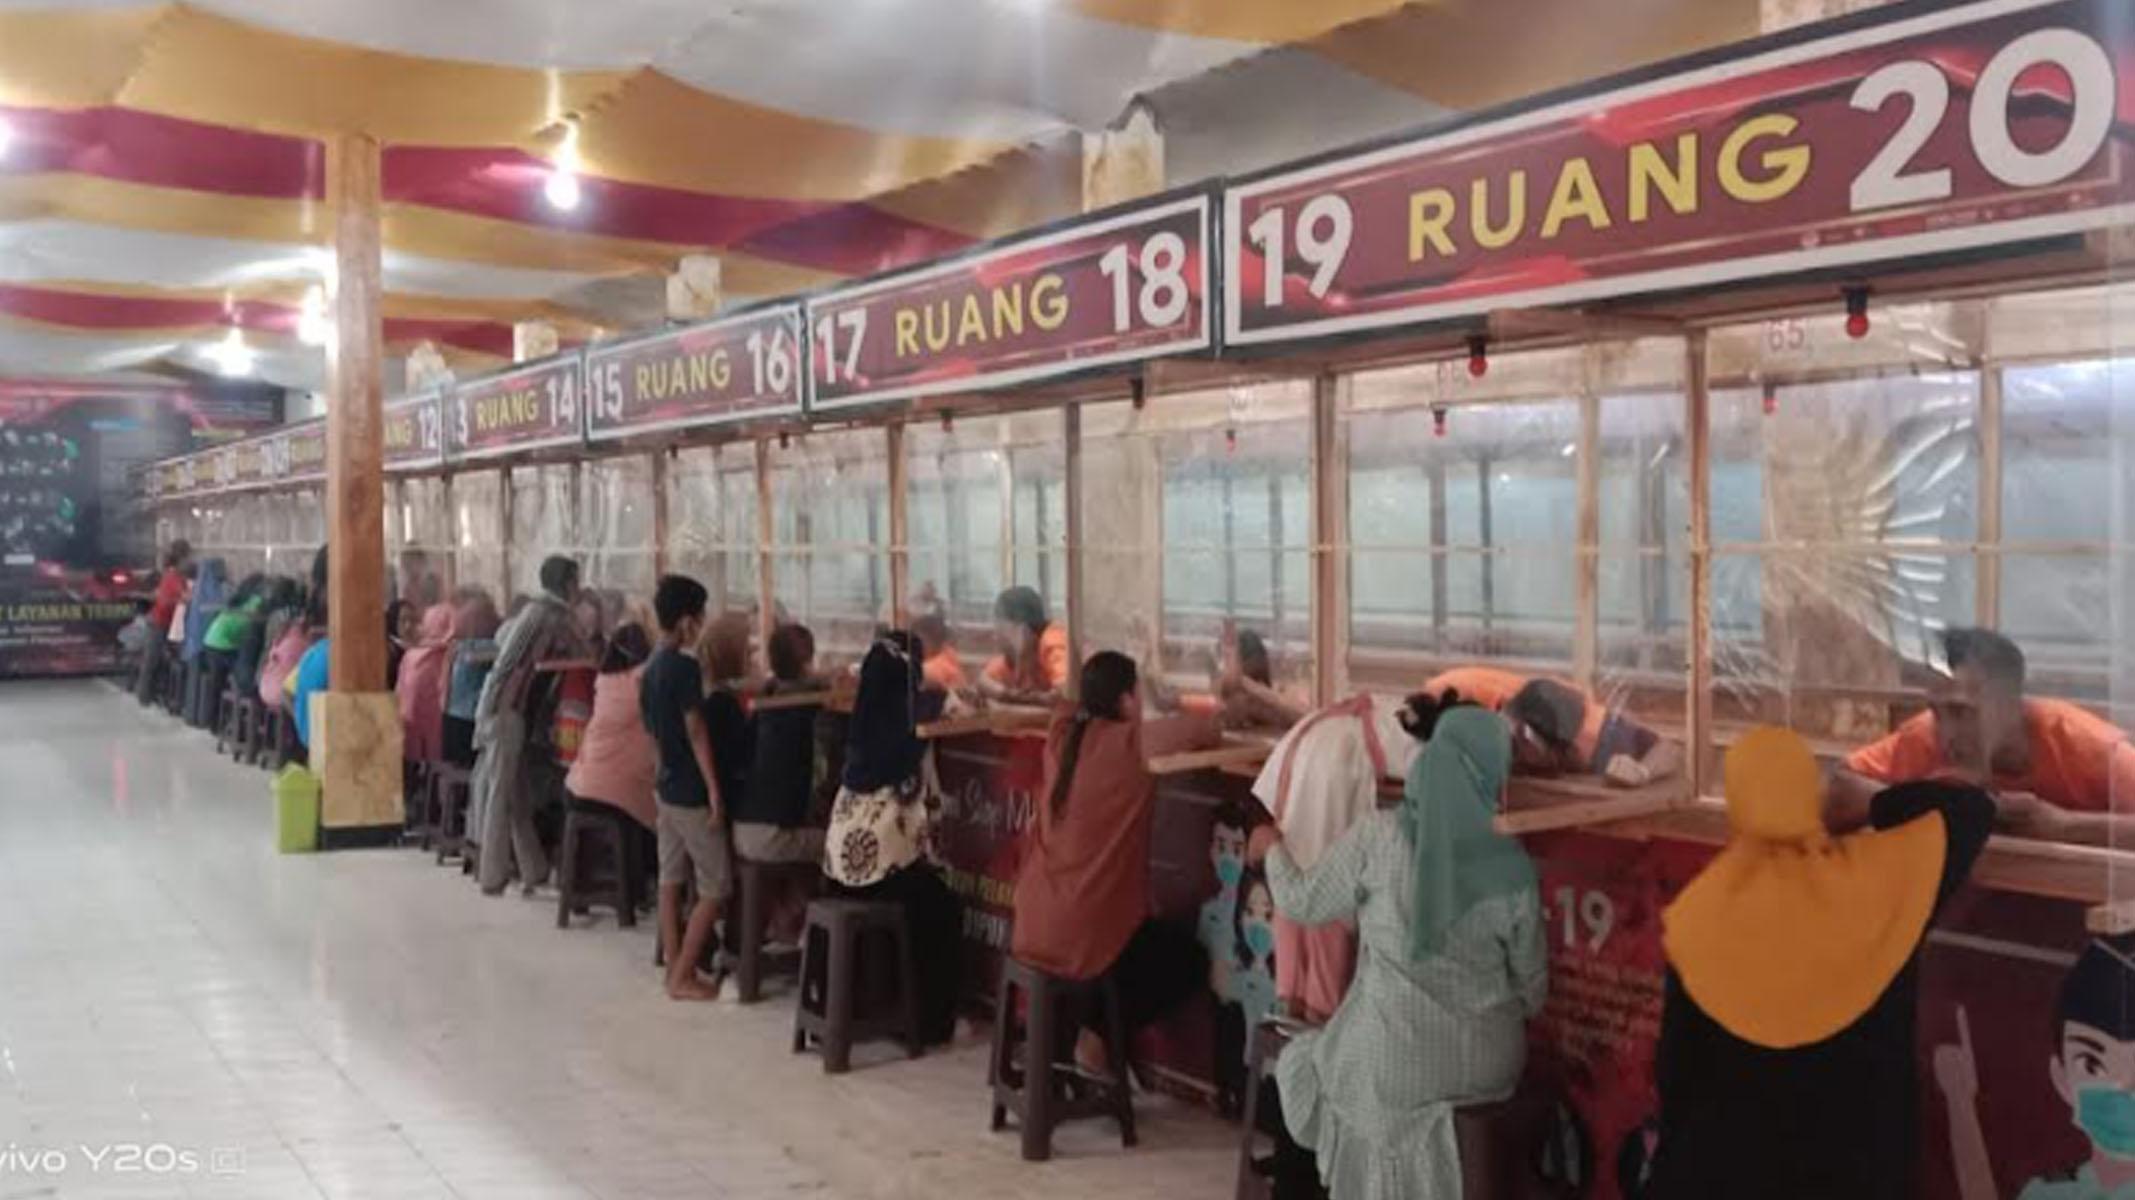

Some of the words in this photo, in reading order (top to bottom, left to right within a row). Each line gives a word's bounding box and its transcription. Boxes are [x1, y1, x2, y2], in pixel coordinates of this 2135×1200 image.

[1249, 194, 1353, 307] 19
[1408, 114, 1811, 262] RUANG
[1849, 27, 2116, 212] 20
[815, 307, 867, 384] 17
[895, 274, 1068, 357] RUANG
[1099, 231, 1187, 333] 18
[476, 389, 539, 431] RUANG
[546, 371, 575, 427] 14
[592, 362, 623, 419] 15
[636, 348, 731, 400] RUANG
[747, 326, 790, 395] 16
